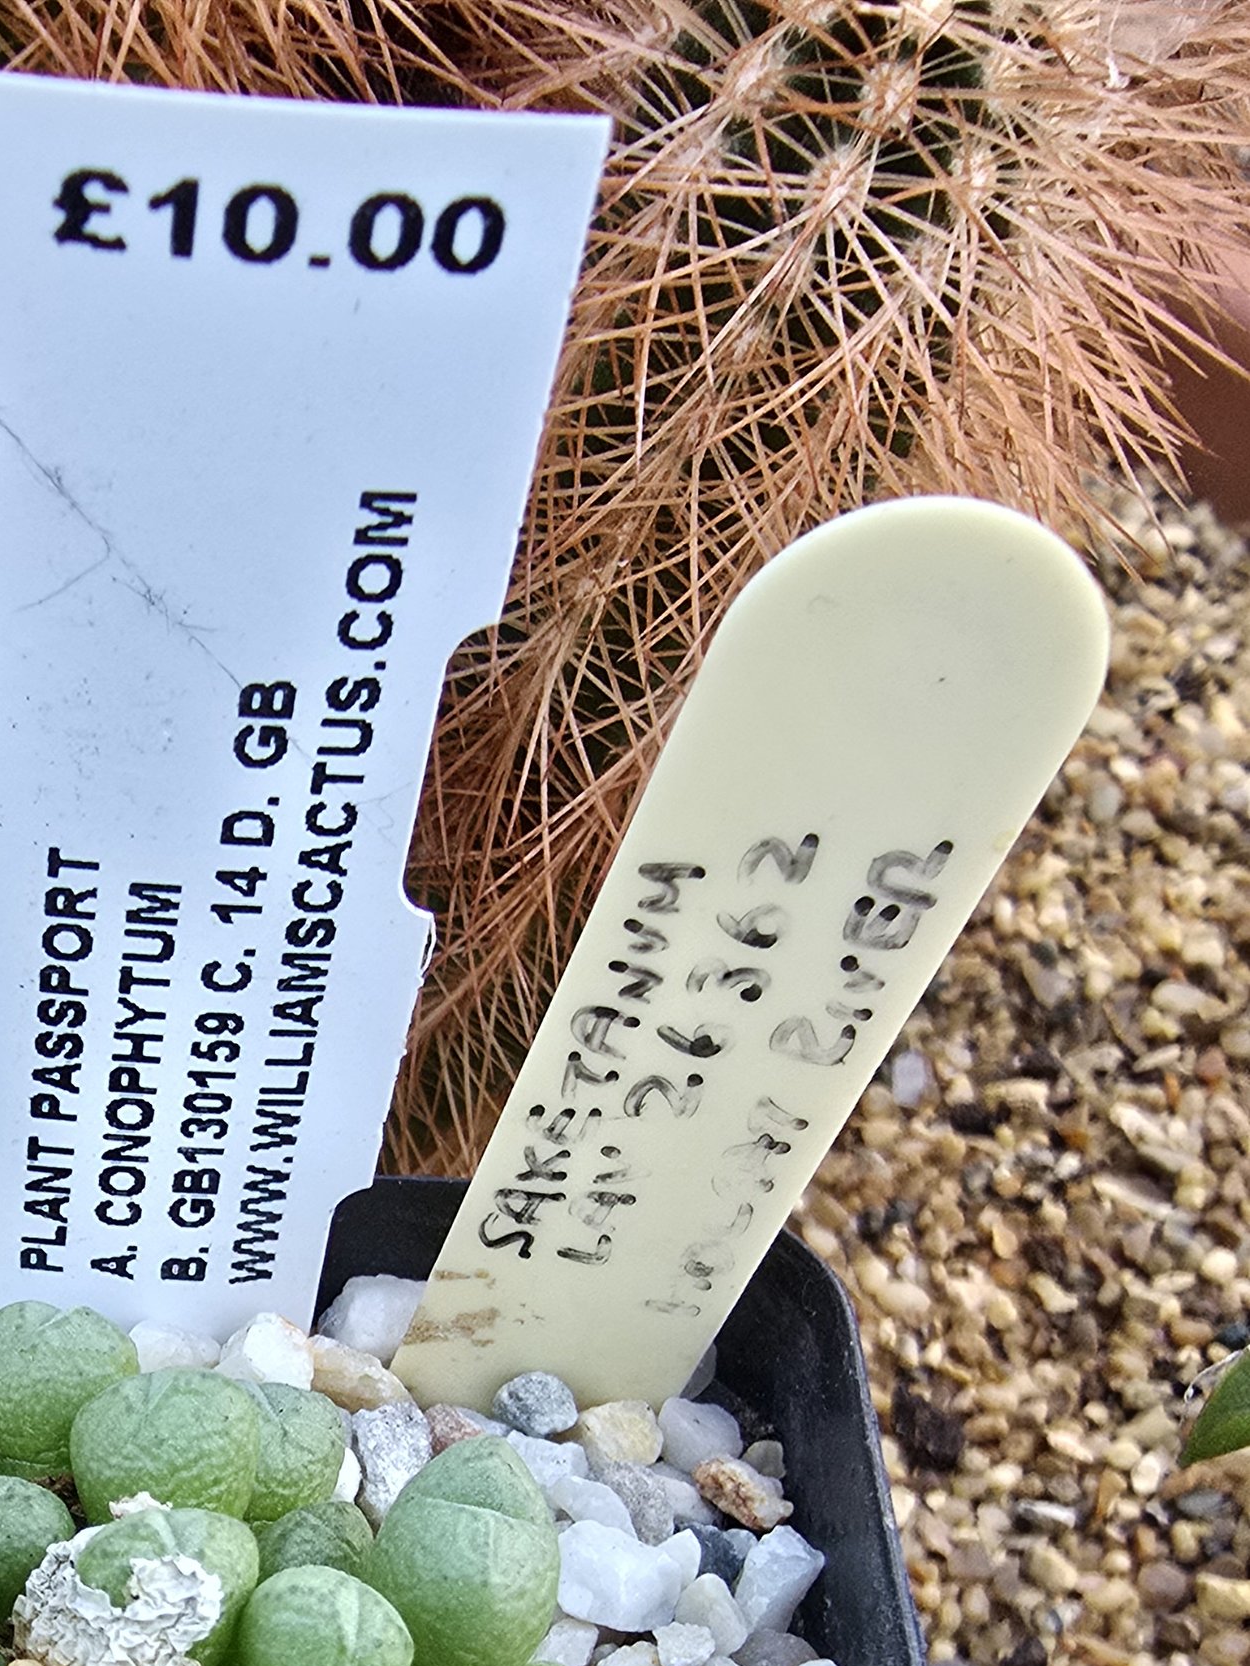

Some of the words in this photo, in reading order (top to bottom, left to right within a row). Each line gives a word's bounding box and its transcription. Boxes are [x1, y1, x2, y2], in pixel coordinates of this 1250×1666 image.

[51, 166, 506, 275] £10.00
[234, 680, 297, 770] GB
[219, 796, 280, 847] D.
[211, 866, 268, 925] 14
[228, 491, 417, 1284] WWW.WILLIAMSCACTUS.COM
[30, 846, 100, 1121] PASSPORT
[200, 948, 257, 993] C.
[94, 882, 182, 1226] CONOPHYTUM
[167, 1012, 246, 1228] GB130159
[20, 1136, 75, 1273] PLANT
[90, 1245, 138, 1281] A.
[160, 1247, 210, 1282] B.
